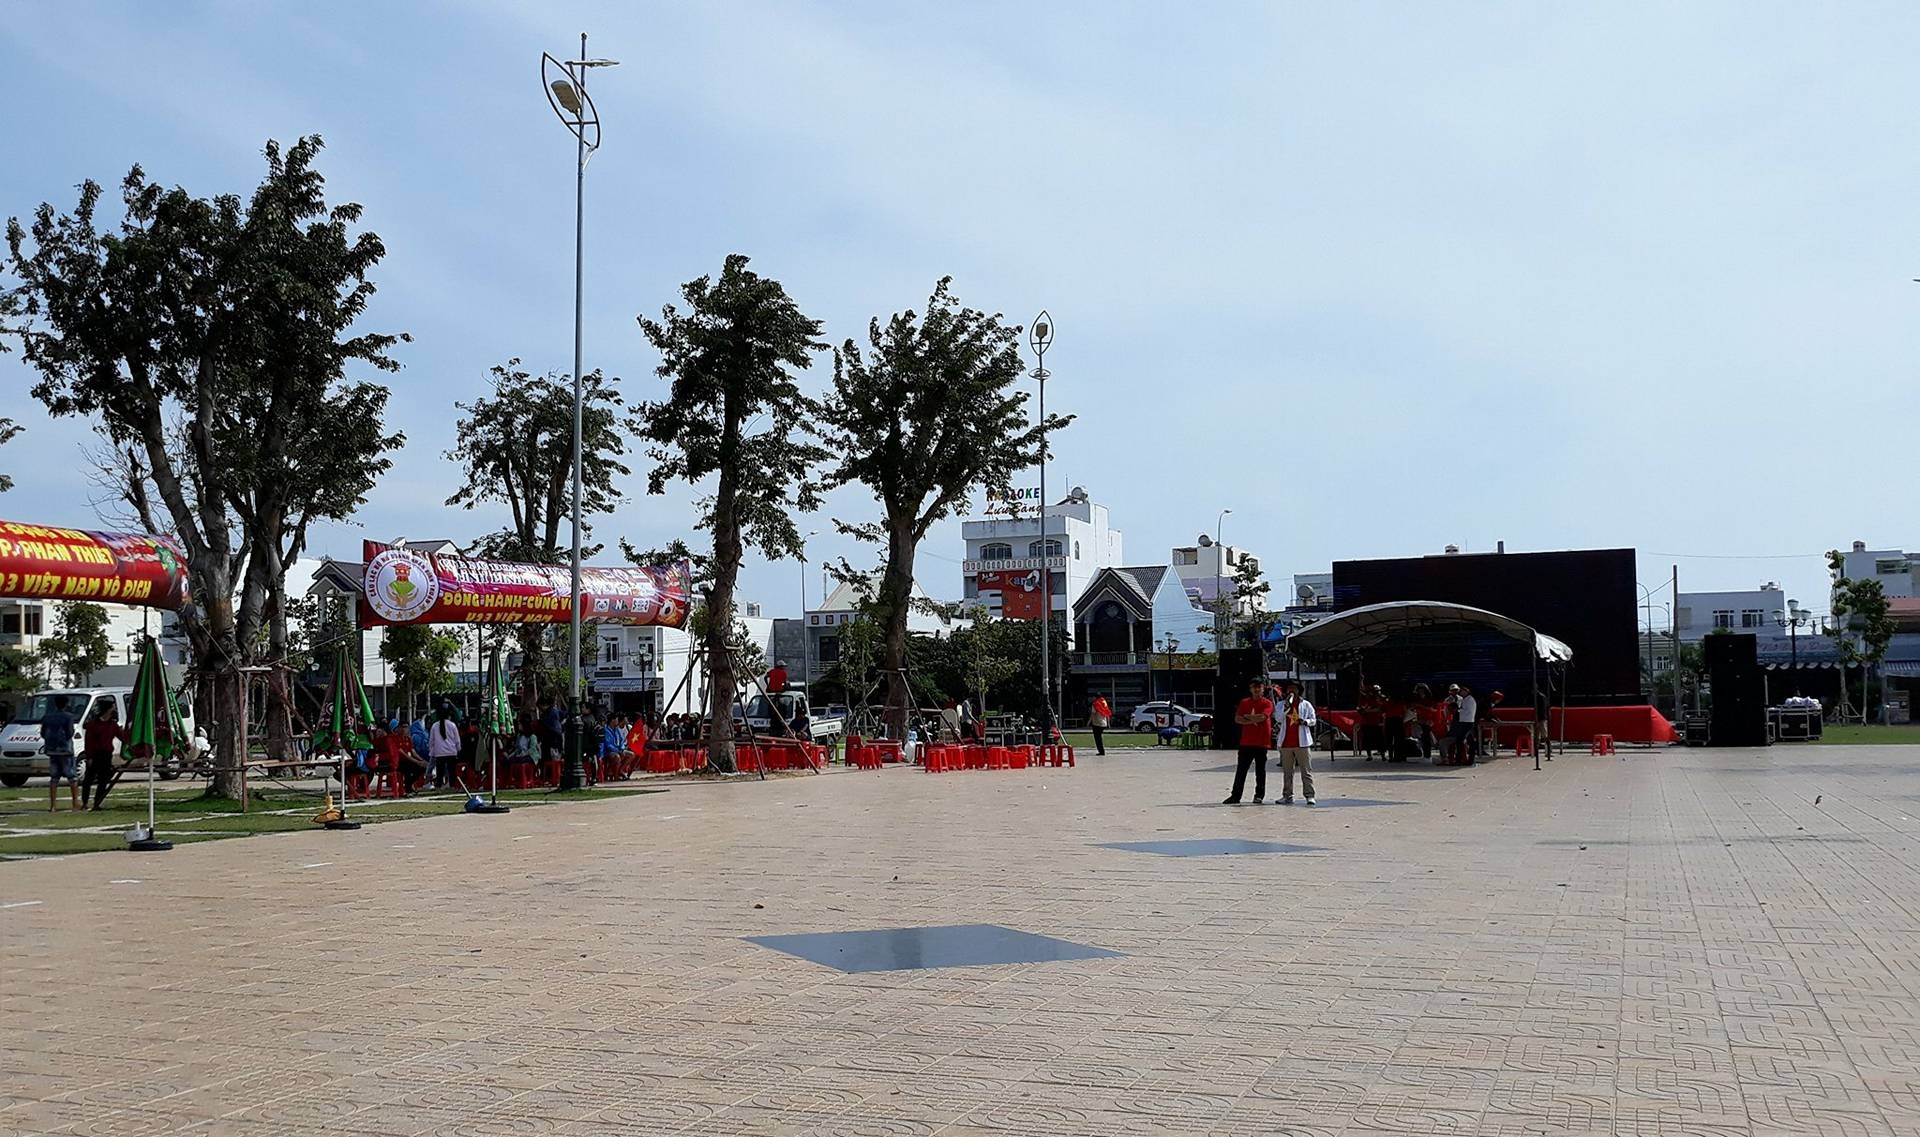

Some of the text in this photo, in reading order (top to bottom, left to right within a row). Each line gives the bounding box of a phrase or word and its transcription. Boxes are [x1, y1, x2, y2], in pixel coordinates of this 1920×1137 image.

[17, 541, 72, 562] PHAN
[69, 543, 115, 566] THIẾT
[22, 571, 61, 596] VIỆT
[62, 575, 101, 597] NAM
[484, 591, 522, 608] HÀNH
